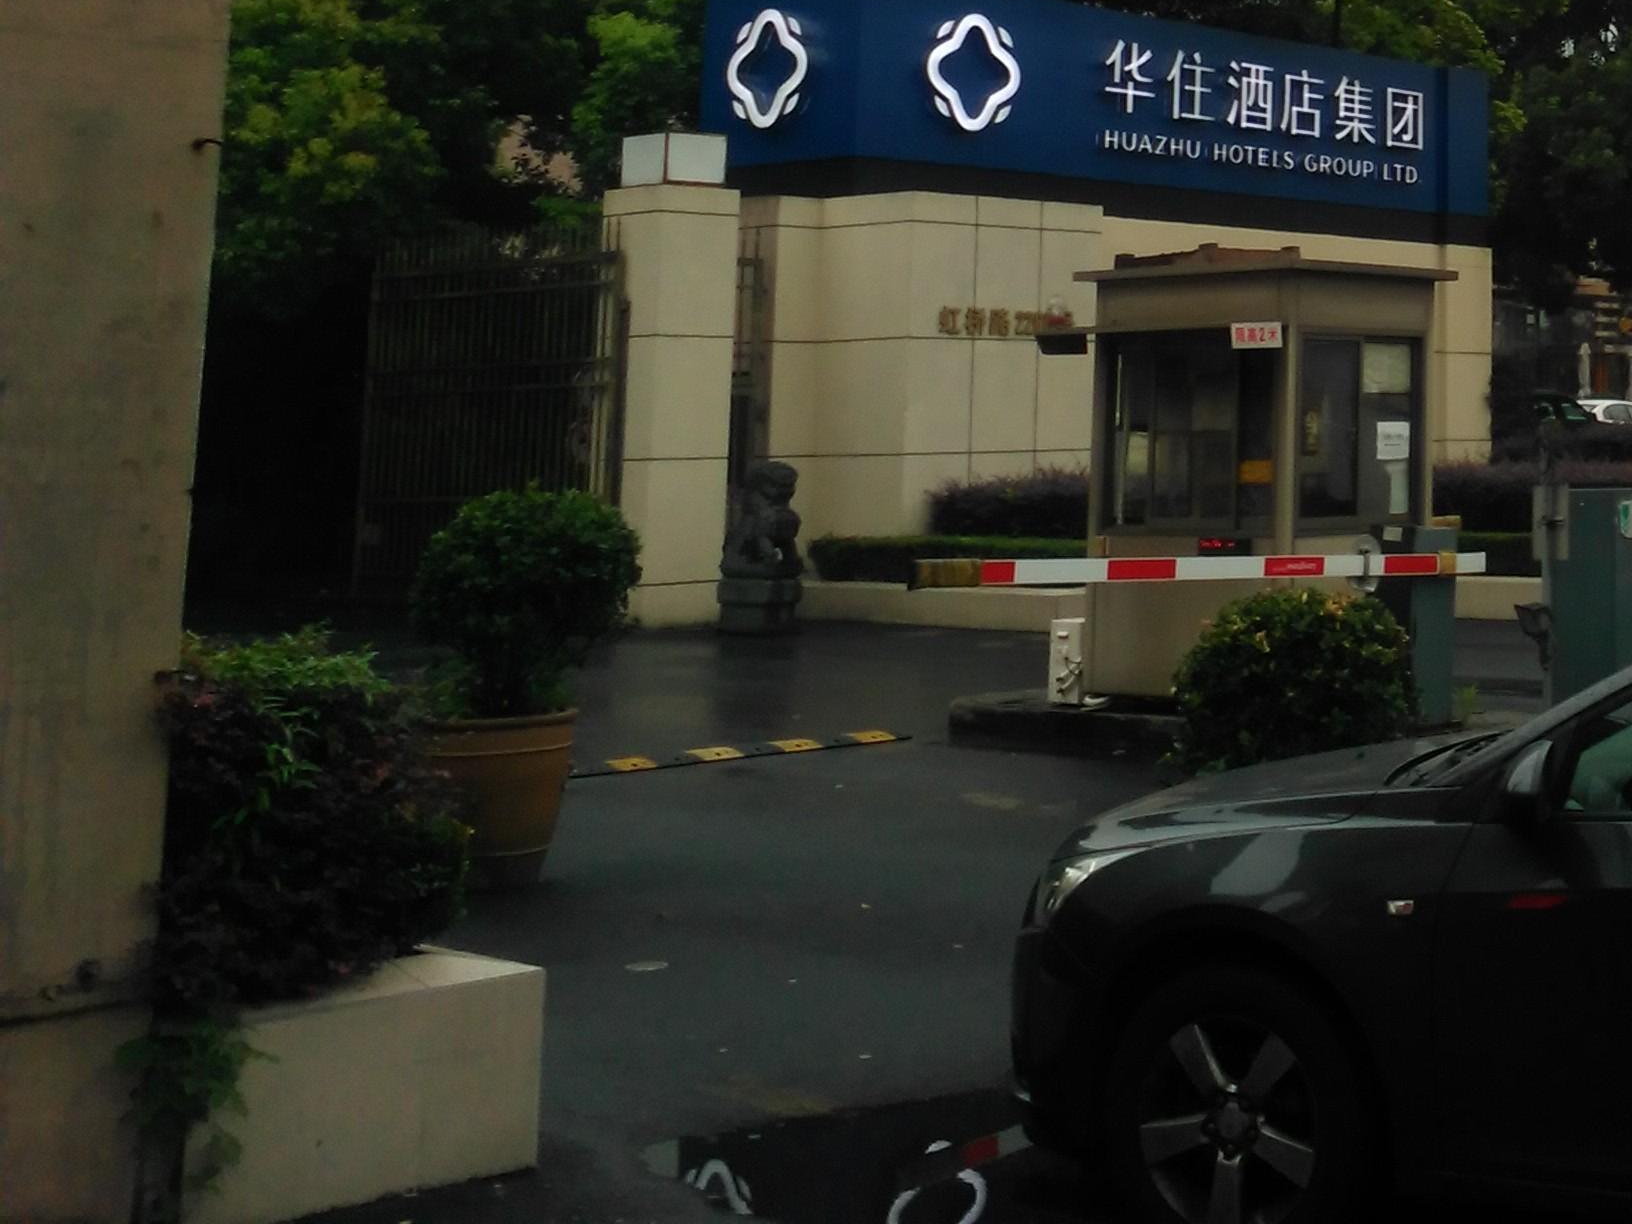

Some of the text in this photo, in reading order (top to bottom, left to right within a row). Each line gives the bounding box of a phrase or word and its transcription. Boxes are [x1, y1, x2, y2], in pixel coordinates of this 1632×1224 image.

[1104, 38, 1424, 151] 华住酒店集团
[1104, 129, 1201, 160] HUAZHU
[1213, 142, 1295, 170] HOTELS
[1303, 152, 1375, 179] GROUP
